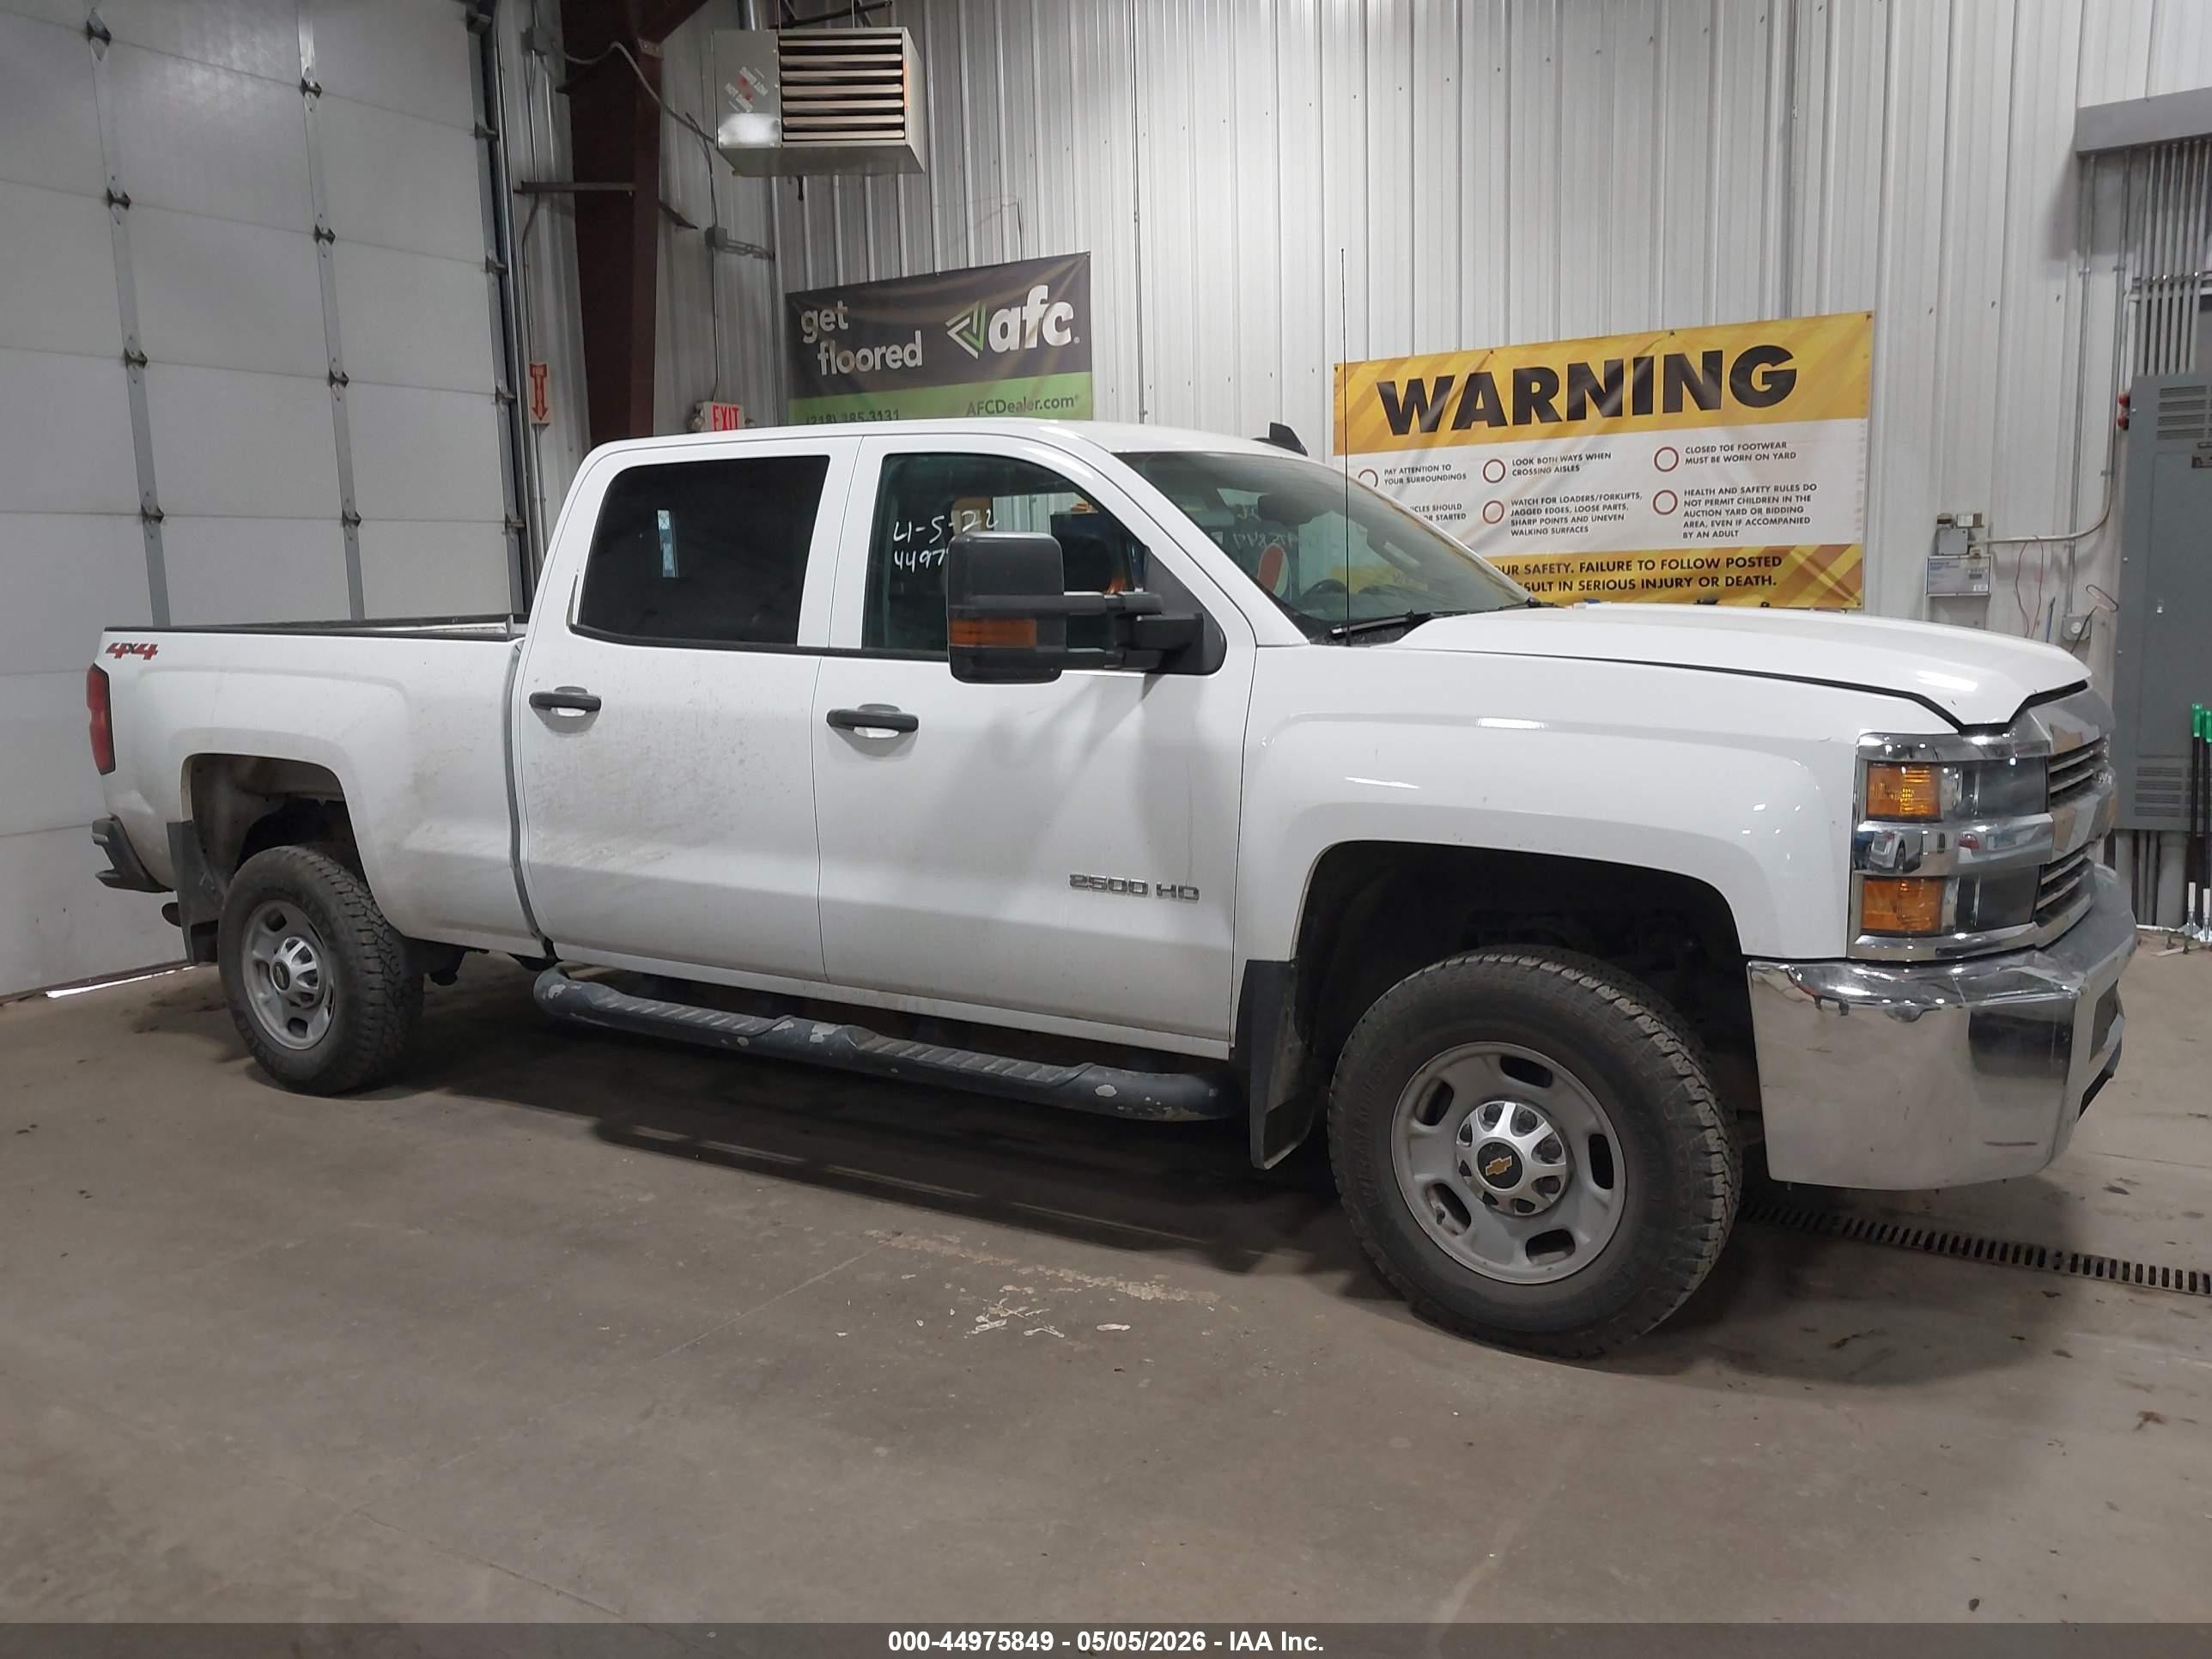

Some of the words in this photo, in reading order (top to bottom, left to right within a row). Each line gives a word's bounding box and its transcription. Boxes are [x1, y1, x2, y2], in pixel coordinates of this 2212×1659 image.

[800, 301, 849, 344] get
[817, 330, 923, 376] floored
[1376, 344, 1798, 436] WARNING
[967, 396, 1074, 416] AFCDealer.com
[713, 404, 740, 431] EXIT
[1685, 445, 1717, 454] CLOSED
[1719, 444, 1735, 453] TOE
[1737, 441, 1787, 451] FOOTWEAR
[1512, 458, 1534, 466] LOOK
[1537, 456, 1558, 465] BOTH
[1559, 453, 1583, 462] WAYS
[1586, 452, 1612, 461] WHEN
[1685, 456, 1708, 465] MUST
[1723, 454, 1753, 463] WORN
[1773, 452, 1796, 460] YARD
[1399, 465, 1439, 475] ATTENTION
[1442, 463, 1452, 471] TO
[1512, 465, 1553, 477] CROSSING
[1554, 465, 1581, 473] AISLES
[1407, 472, 1467, 484] SURROUNDINGS
[1684, 488, 1716, 496] HEALTH
[1718, 487, 1737, 495] AND
[1740, 485, 1771, 494] SAFETY
[1773, 483, 1800, 493] RULES
[1802, 483, 1817, 492] DO
[1510, 497, 1539, 507] WATCH
[1559, 491, 1643, 503] LOADERS/FORKLIFTS,
[1684, 499, 1702, 507] NOT
[1705, 497, 1735, 506] PERMIT
[1736, 495, 1779, 505] CHILDREN
[1782, 495, 1792, 503] IN
[1796, 494, 1812, 502] THE
[1432, 503, 1462, 512] SHOULD
[1510, 507, 1542, 517] JAGGED
[1574, 504, 1600, 513] LOOSE
[1602, 502, 1629, 511] PARTS,
[1683, 509, 1722, 518] AUCTION
[1724, 507, 1747, 516] YARD
[1750, 507, 1763, 515] OR
[1765, 505, 1804, 514] BIDDING
[1435, 513, 1467, 521] STARTED
[1510, 518, 1538, 526] SHARP
[1540, 516, 1568, 525] POINTS
[1591, 514, 1625, 522] UNEVEN
[1683, 520, 1708, 529] AREA,
[1711, 519, 1733, 527] EVEN
[1735, 518, 1742, 526] IF
[1745, 516, 1811, 526] ACCOMPANIED
[1510, 527, 1548, 537] WALKING
[1551, 526, 1589, 534] SURFACES
[1682, 531, 1693, 539] BY
[1696, 530, 1710, 538] AN
[1712, 529, 1739, 538] ADULT
[894, 547, 949, 573] 4497
[1523, 562, 1575, 574] SAFETY.
[1579, 560, 1632, 573] FAILURE
[1638, 559, 1656, 571] TO
[1661, 557, 1720, 570] FOLLOW
[1725, 556, 1783, 568] POSTED
[1518, 580, 1554, 592] SULT
[1558, 580, 1573, 592] IN
[1578, 578, 1636, 591] SERIOUS
[1641, 576, 1693, 590] INJURY
[1698, 575, 1720, 587] OR
[1724, 574, 1778, 587] DEATH.
[1069, 873, 1149, 895] 2500
[1156, 882, 1200, 901] HD
